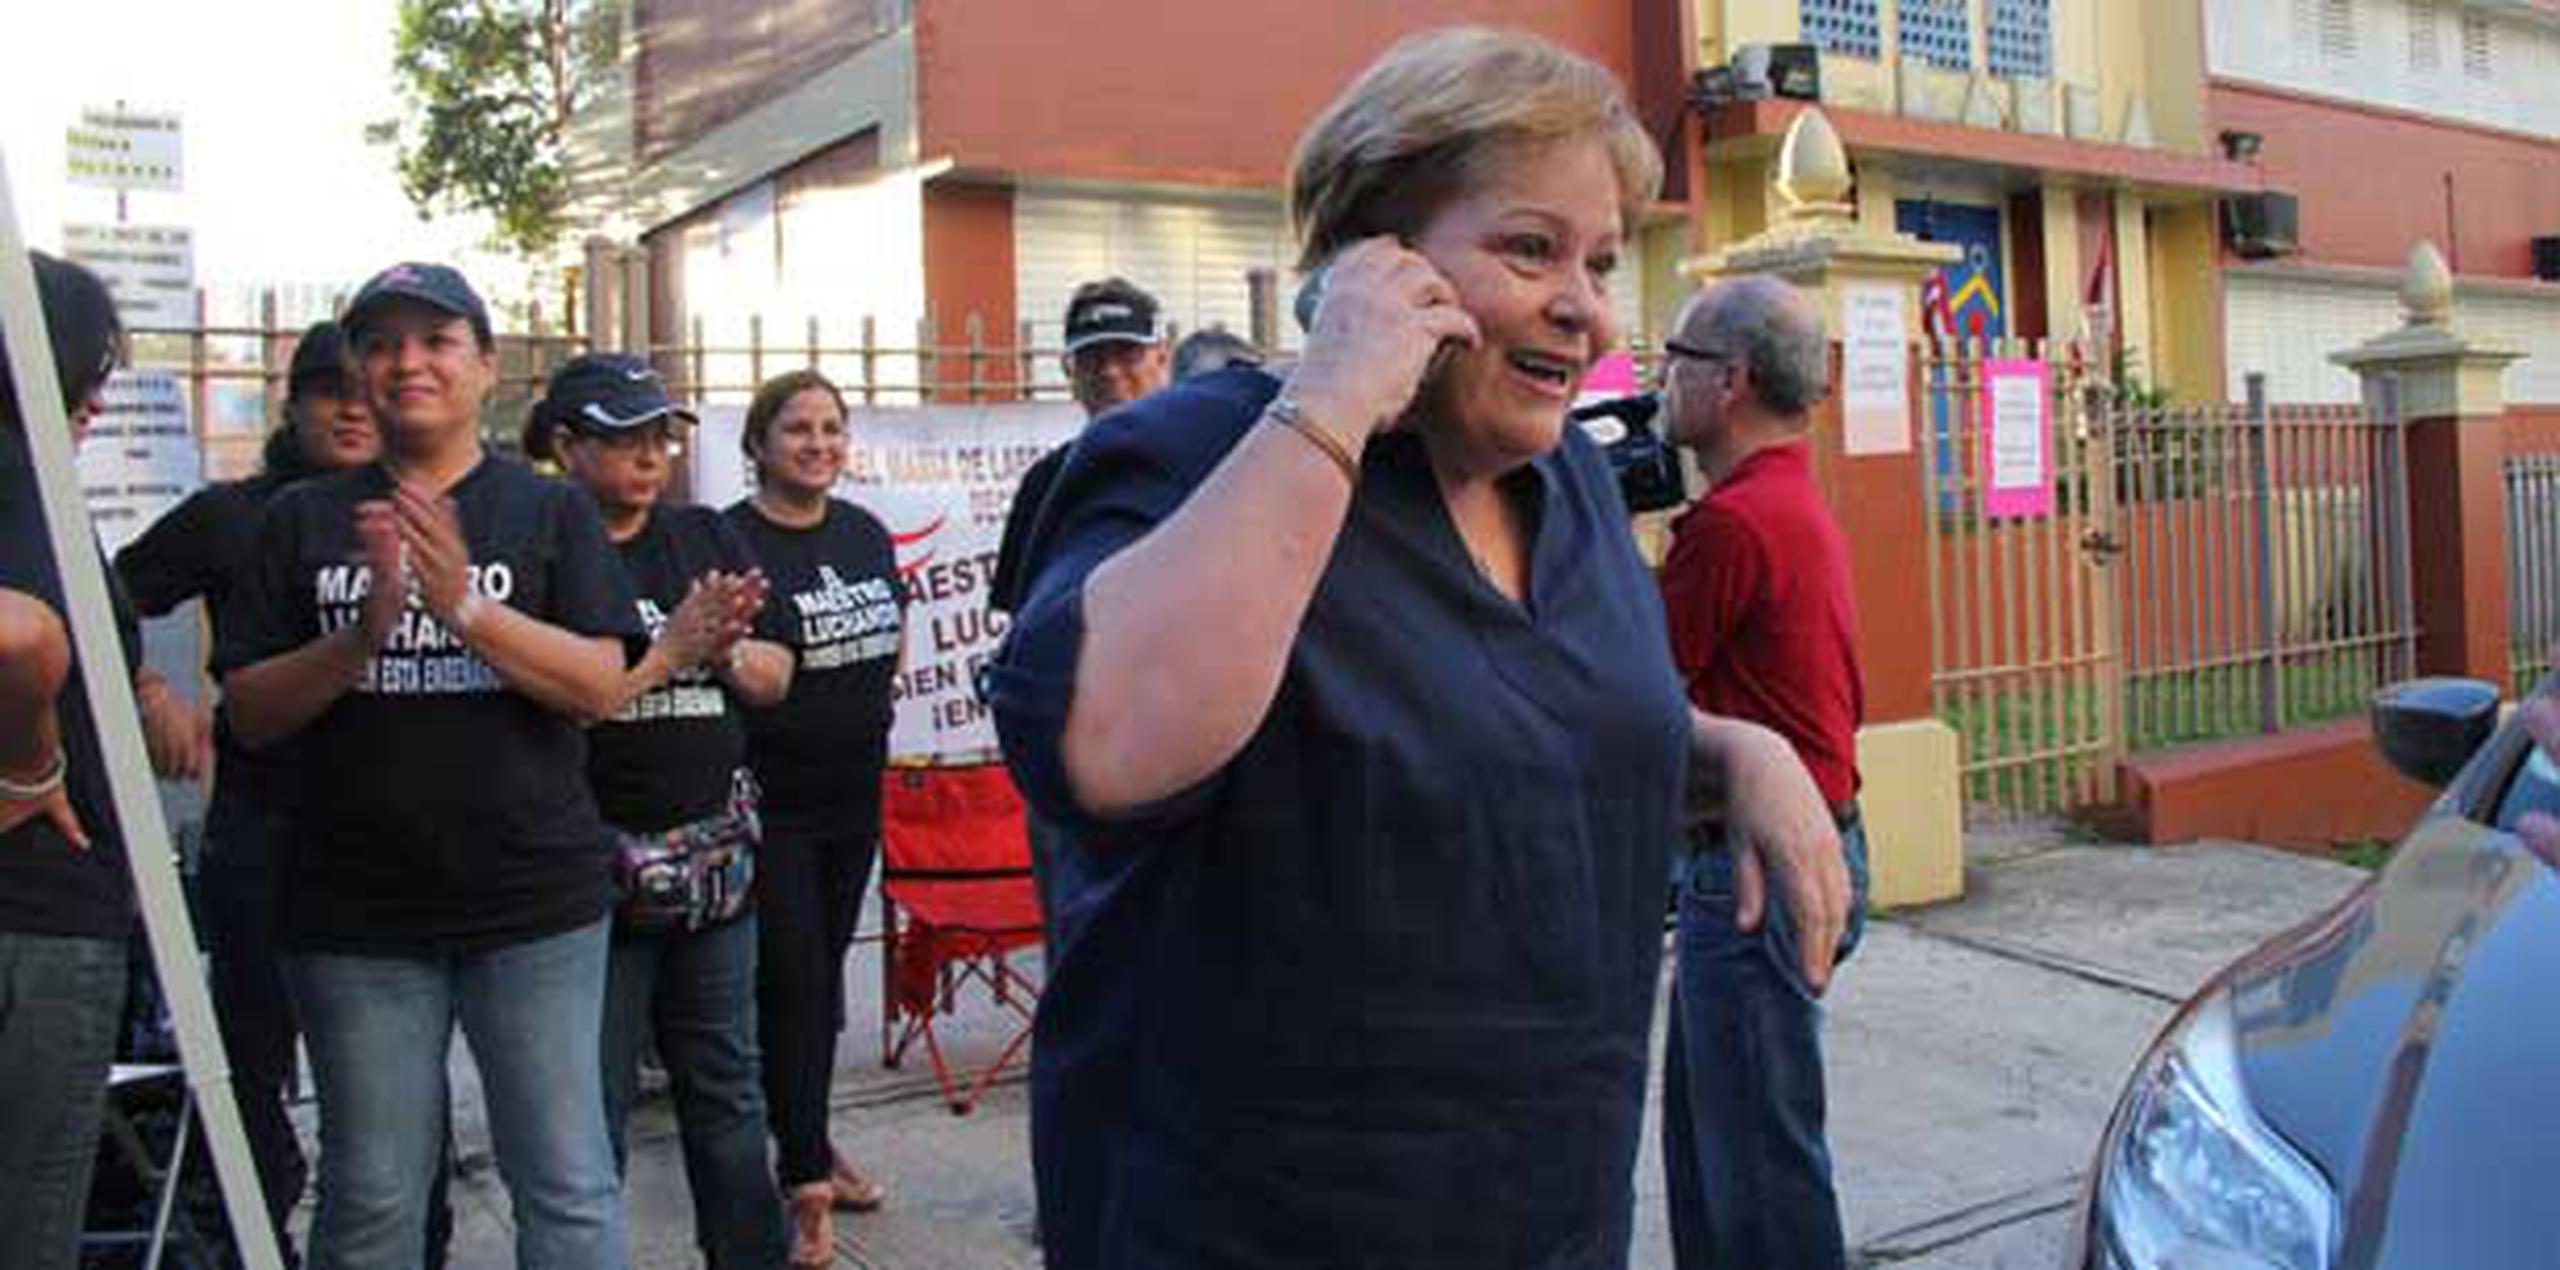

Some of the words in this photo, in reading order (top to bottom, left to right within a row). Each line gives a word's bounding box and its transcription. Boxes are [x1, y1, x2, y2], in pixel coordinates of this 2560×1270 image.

[316, 563, 513, 604] MARO
[793, 578, 892, 617] MAESTRO
[897, 551, 1000, 604] AEST
[932, 607, 1006, 650] LUC
[931, 696, 987, 731] ¡EN
